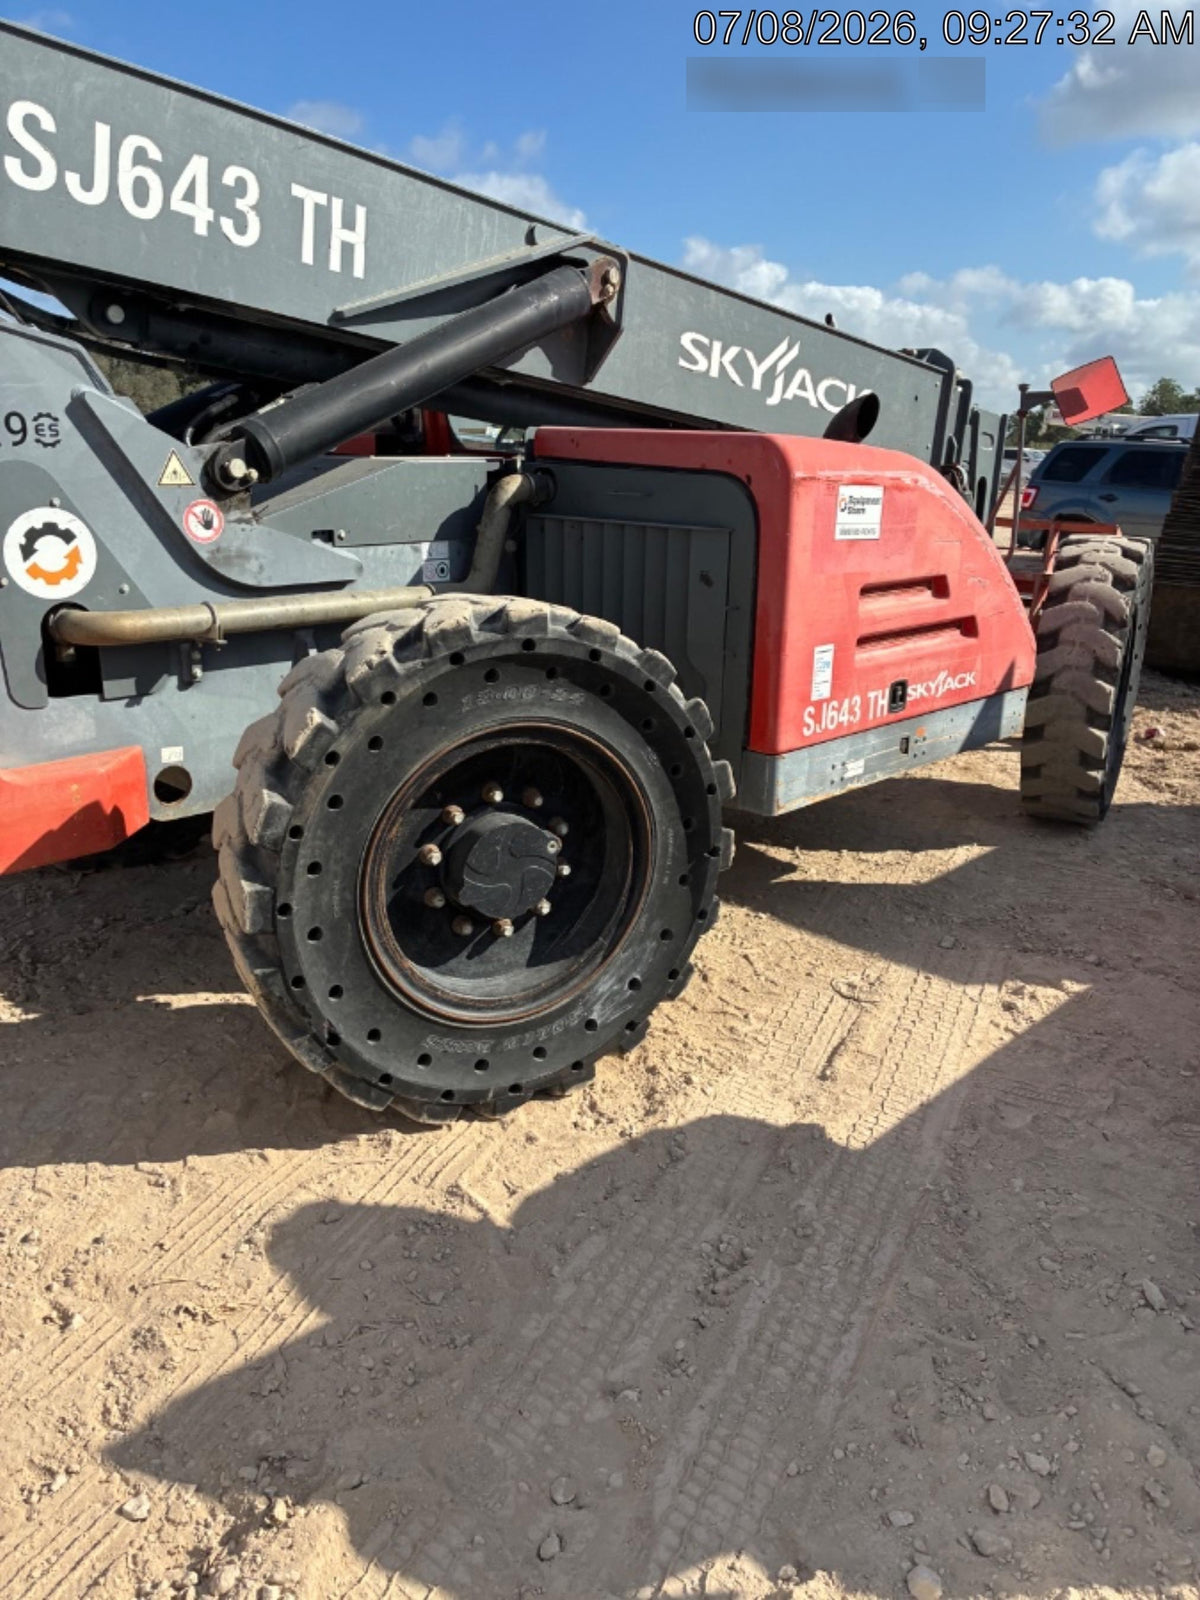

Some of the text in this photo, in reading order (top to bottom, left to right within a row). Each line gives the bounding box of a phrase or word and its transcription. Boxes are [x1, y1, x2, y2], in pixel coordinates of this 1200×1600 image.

[4, 100, 367, 279] SJ643 TH
[0, 410, 28, 447] 9
[906, 670, 976, 702] SKYJACK
[802, 688, 890, 737] SJ643 TH
